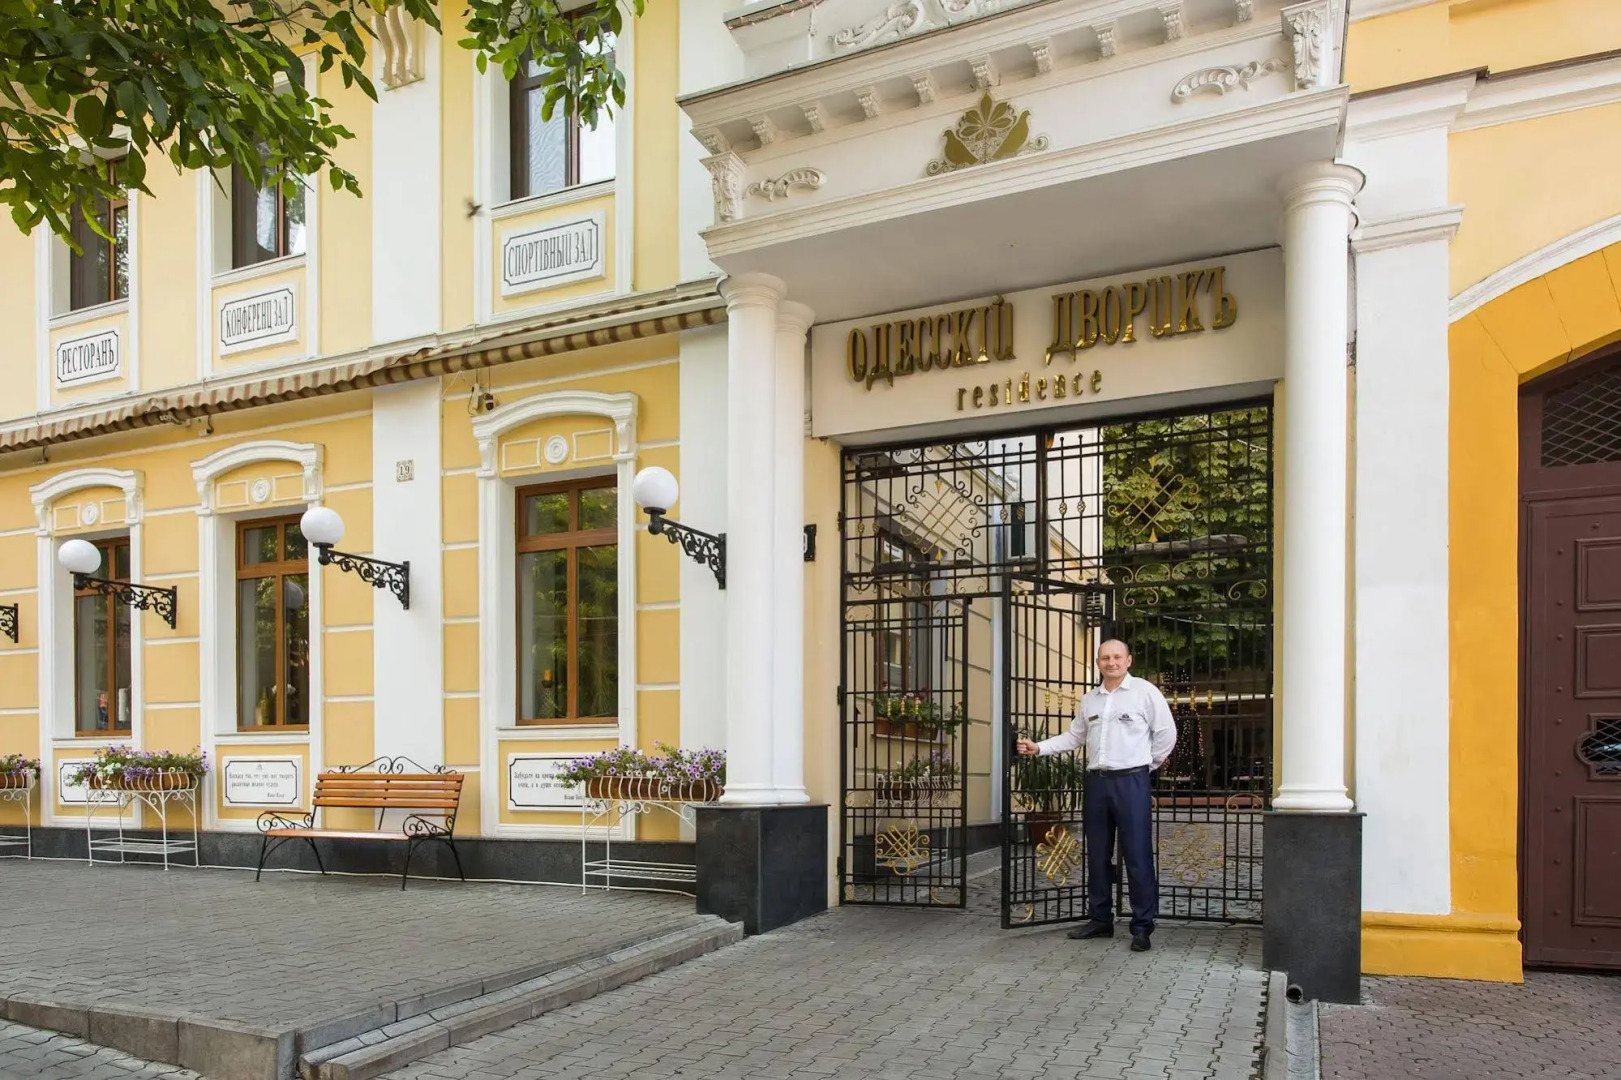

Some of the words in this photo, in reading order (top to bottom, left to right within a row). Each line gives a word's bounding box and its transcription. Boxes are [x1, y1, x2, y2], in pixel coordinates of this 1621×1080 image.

[575, 229, 592, 263] ЗАЛ
[226, 300, 272, 338] КОНФЕРЕНЦ
[274, 296, 288, 326] ЗАЛ
[846, 295, 1016, 392] ОДЕССКІЙ
[1045, 265, 1237, 366] ДВОРИКЪ
[62, 339, 114, 375] РЕСТОРАНЪ
[957, 369, 1103, 411] residence
[400, 465, 410, 475] 19
